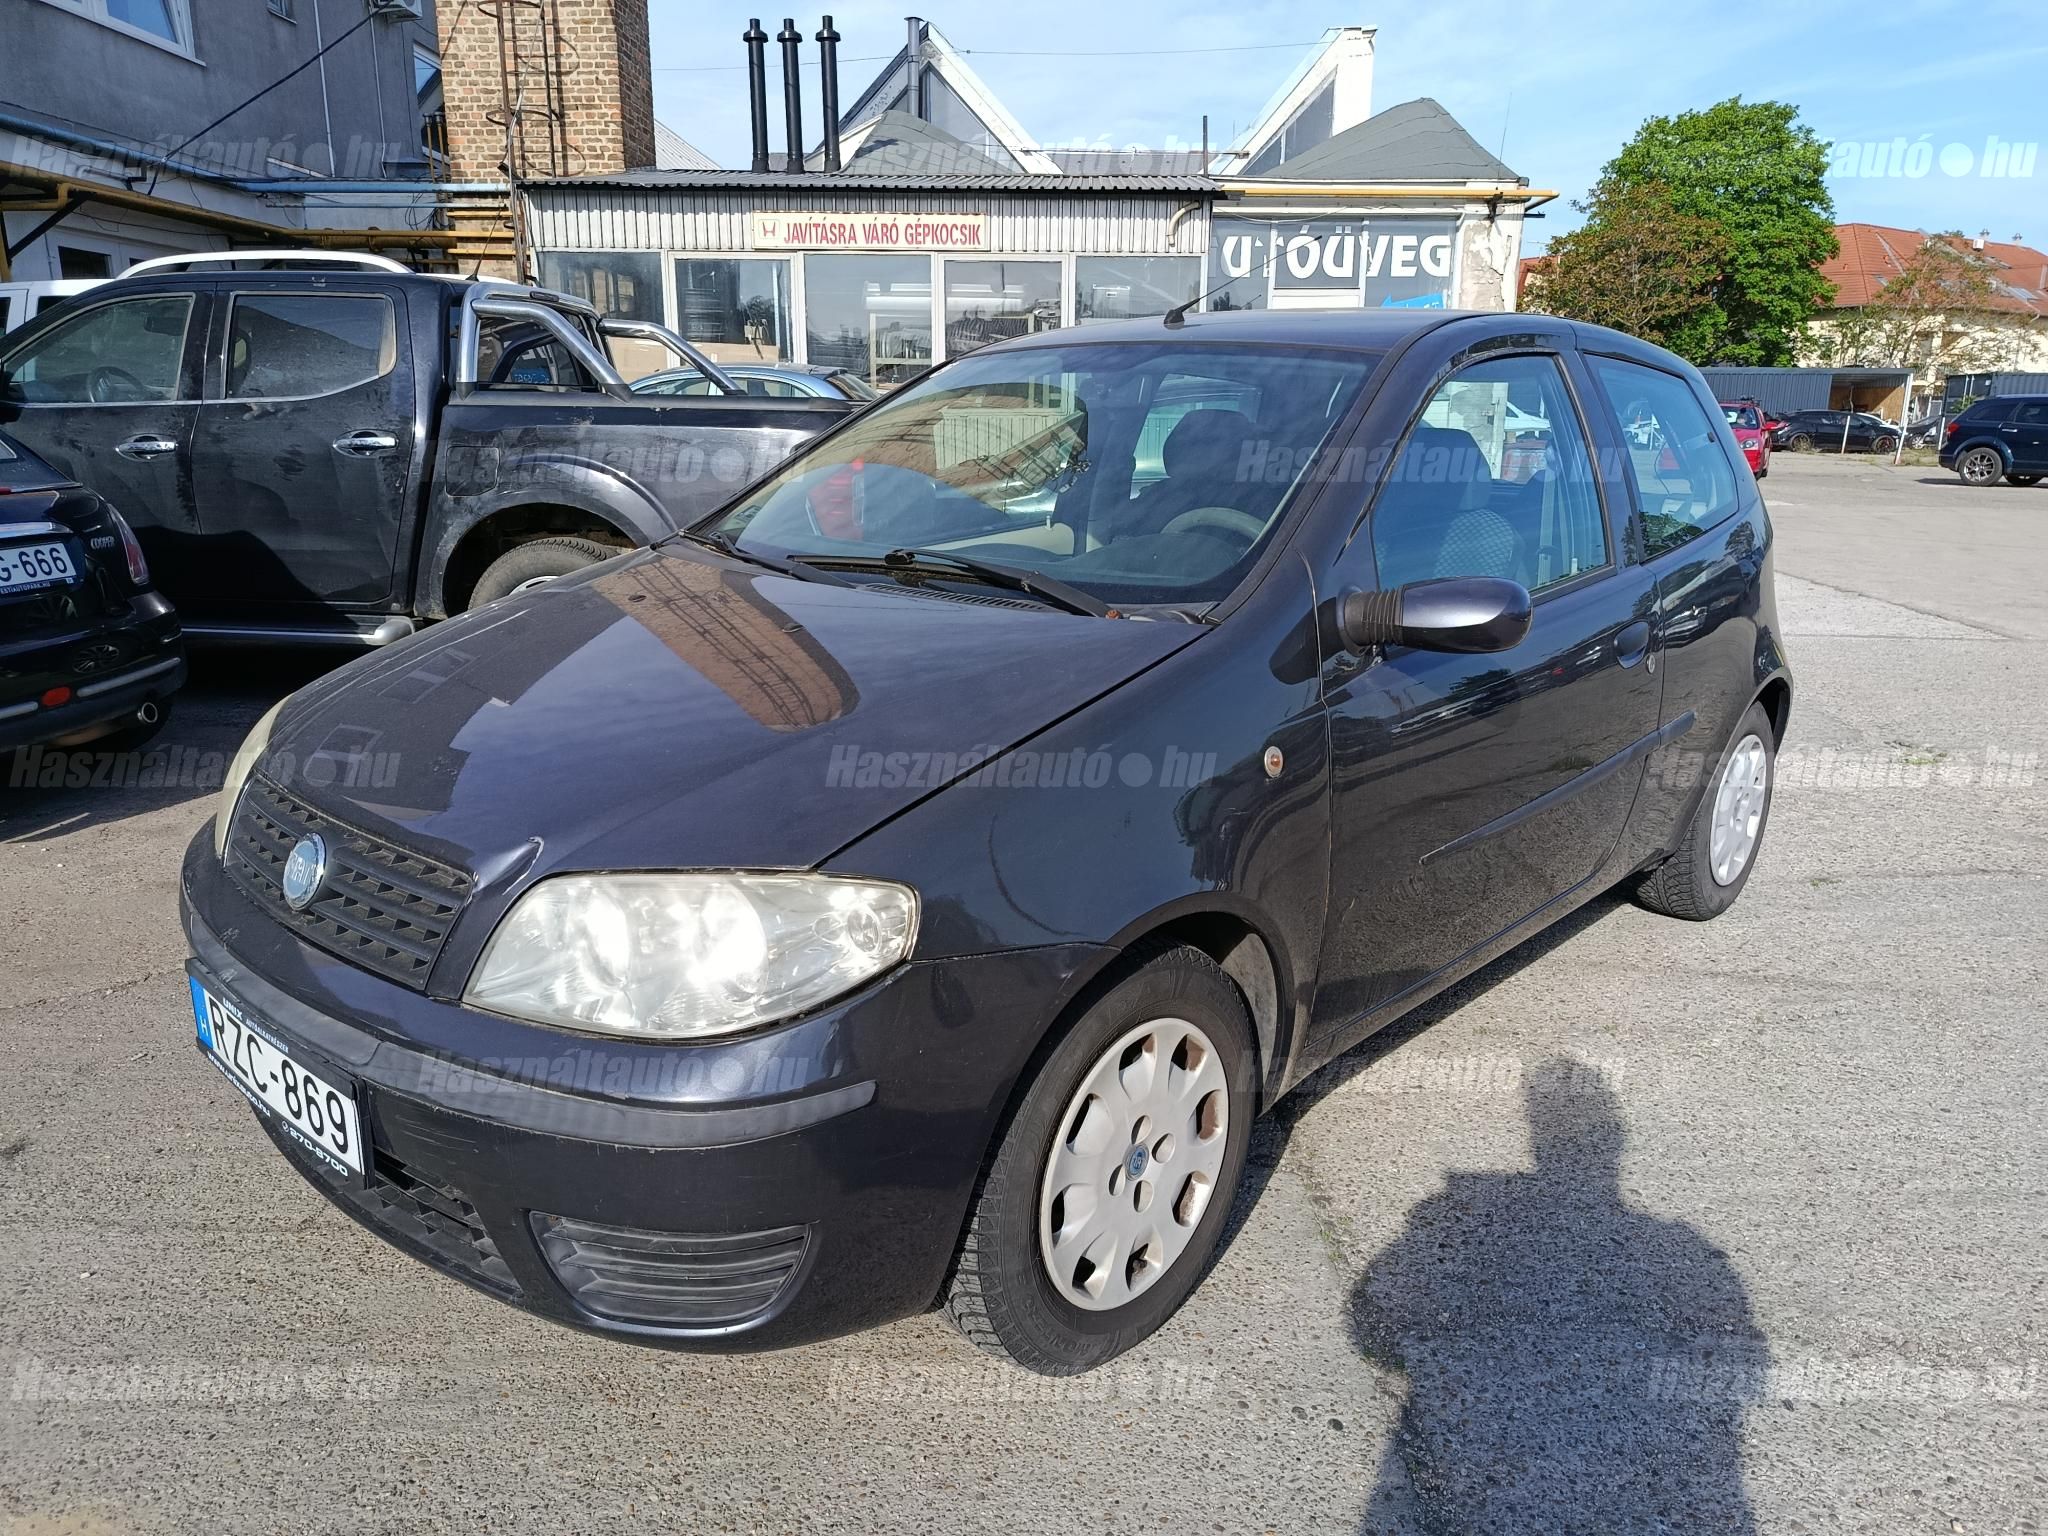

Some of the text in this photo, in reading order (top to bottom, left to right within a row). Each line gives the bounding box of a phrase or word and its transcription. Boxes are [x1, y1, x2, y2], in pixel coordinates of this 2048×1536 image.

[784, 216, 981, 246] JAVÍTÁSRA VÁRÓ GÉPKOCSIK
[1208, 225, 1452, 279] UTÓÜVEG
[222, 997, 243, 1022] UNIX
[208, 996, 348, 1154] RZC-869
[289, 1127, 348, 1177] 270-8700
